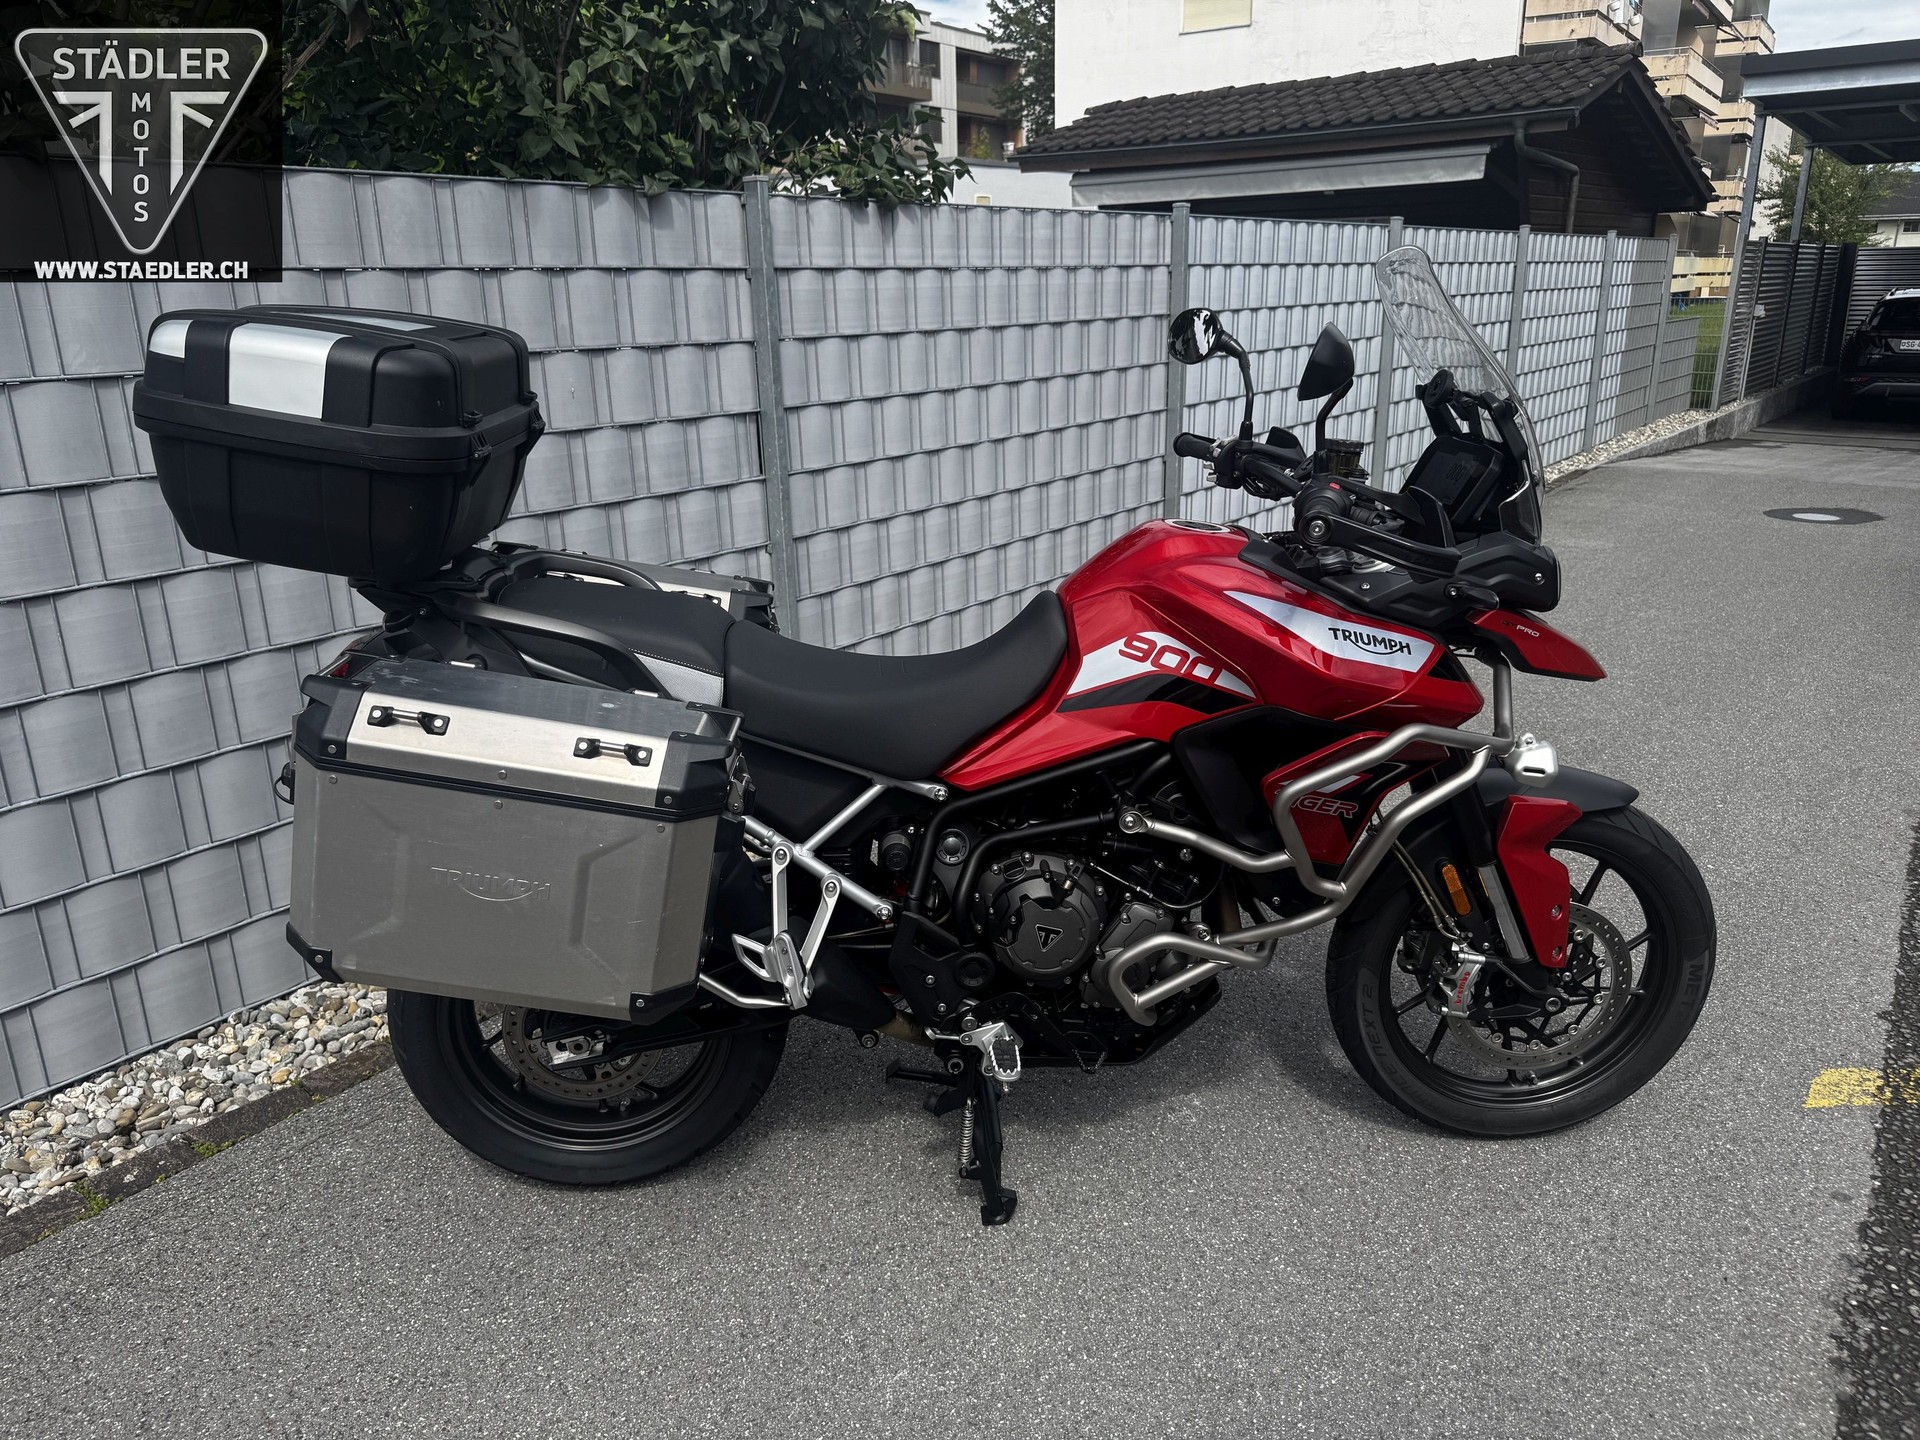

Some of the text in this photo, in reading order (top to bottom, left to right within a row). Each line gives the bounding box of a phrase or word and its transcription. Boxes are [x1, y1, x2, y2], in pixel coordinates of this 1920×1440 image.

[1328, 627, 1412, 656] TRIUMPH
[1516, 624, 1540, 638] PRO
[1118, 633, 1222, 684] 900
[431, 866, 551, 902] TRIUMPH
[1455, 971, 1471, 1005] brembo
